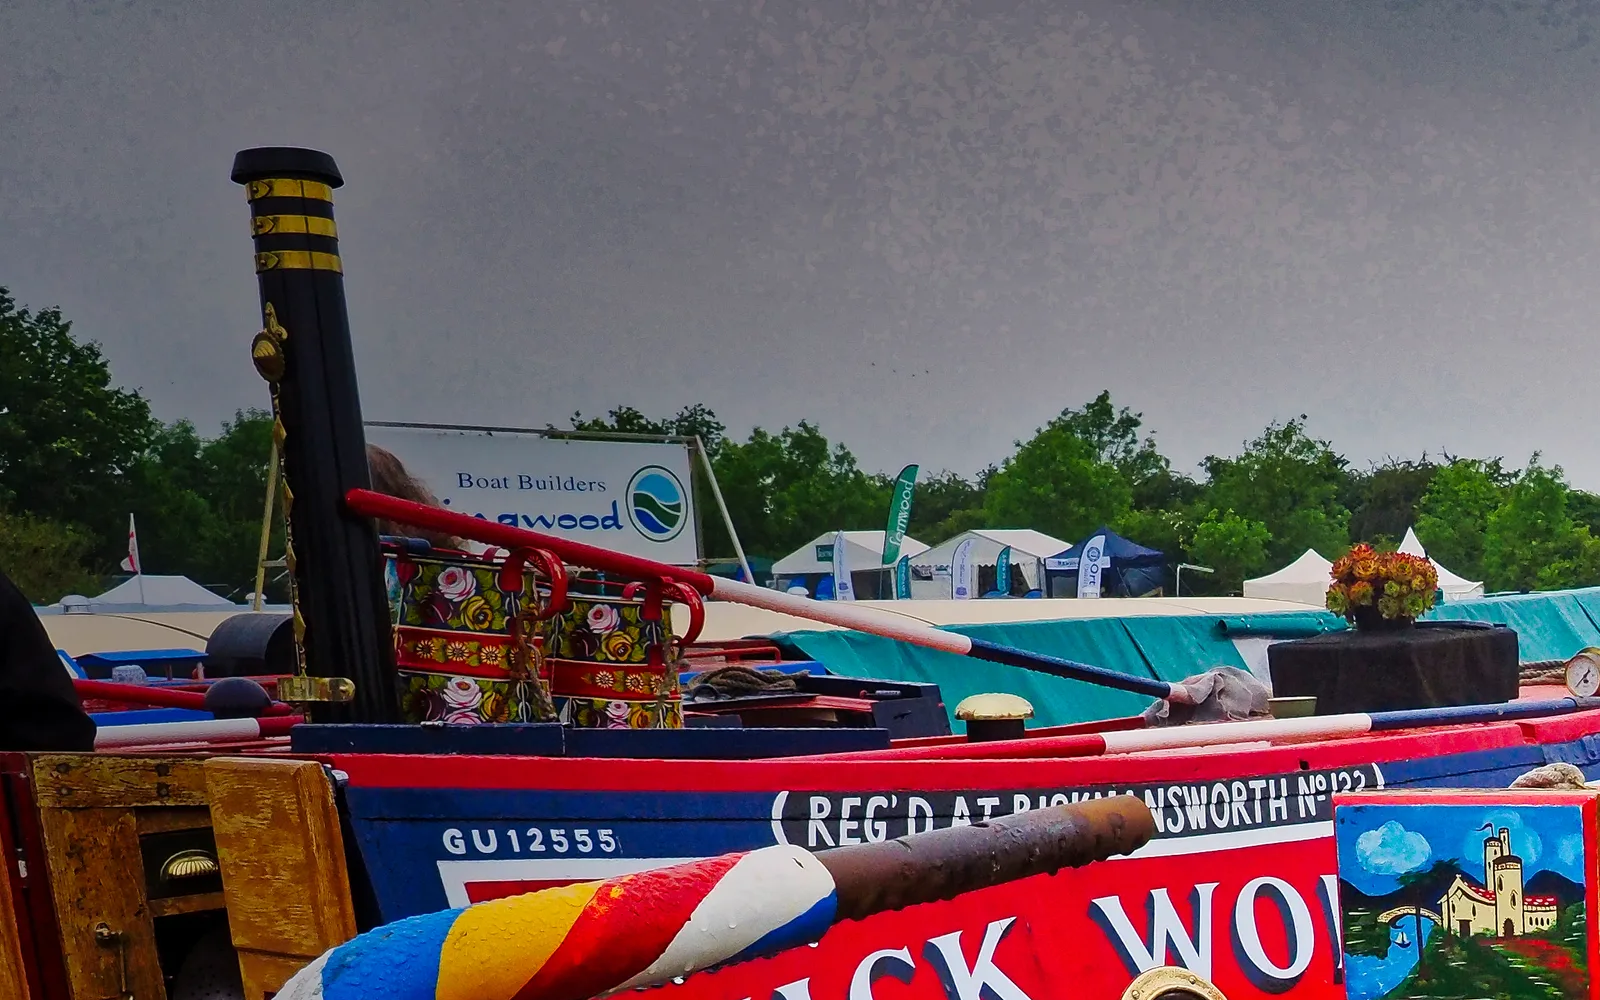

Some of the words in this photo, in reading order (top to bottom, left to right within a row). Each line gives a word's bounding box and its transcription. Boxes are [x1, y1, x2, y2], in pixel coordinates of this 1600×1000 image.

[456, 472, 510, 490] Boat
[518, 474, 607, 493] Builders
[889, 478, 914, 546] fernwood
[950, 794, 1000, 828] AT
[1088, 874, 1343, 985] WO
